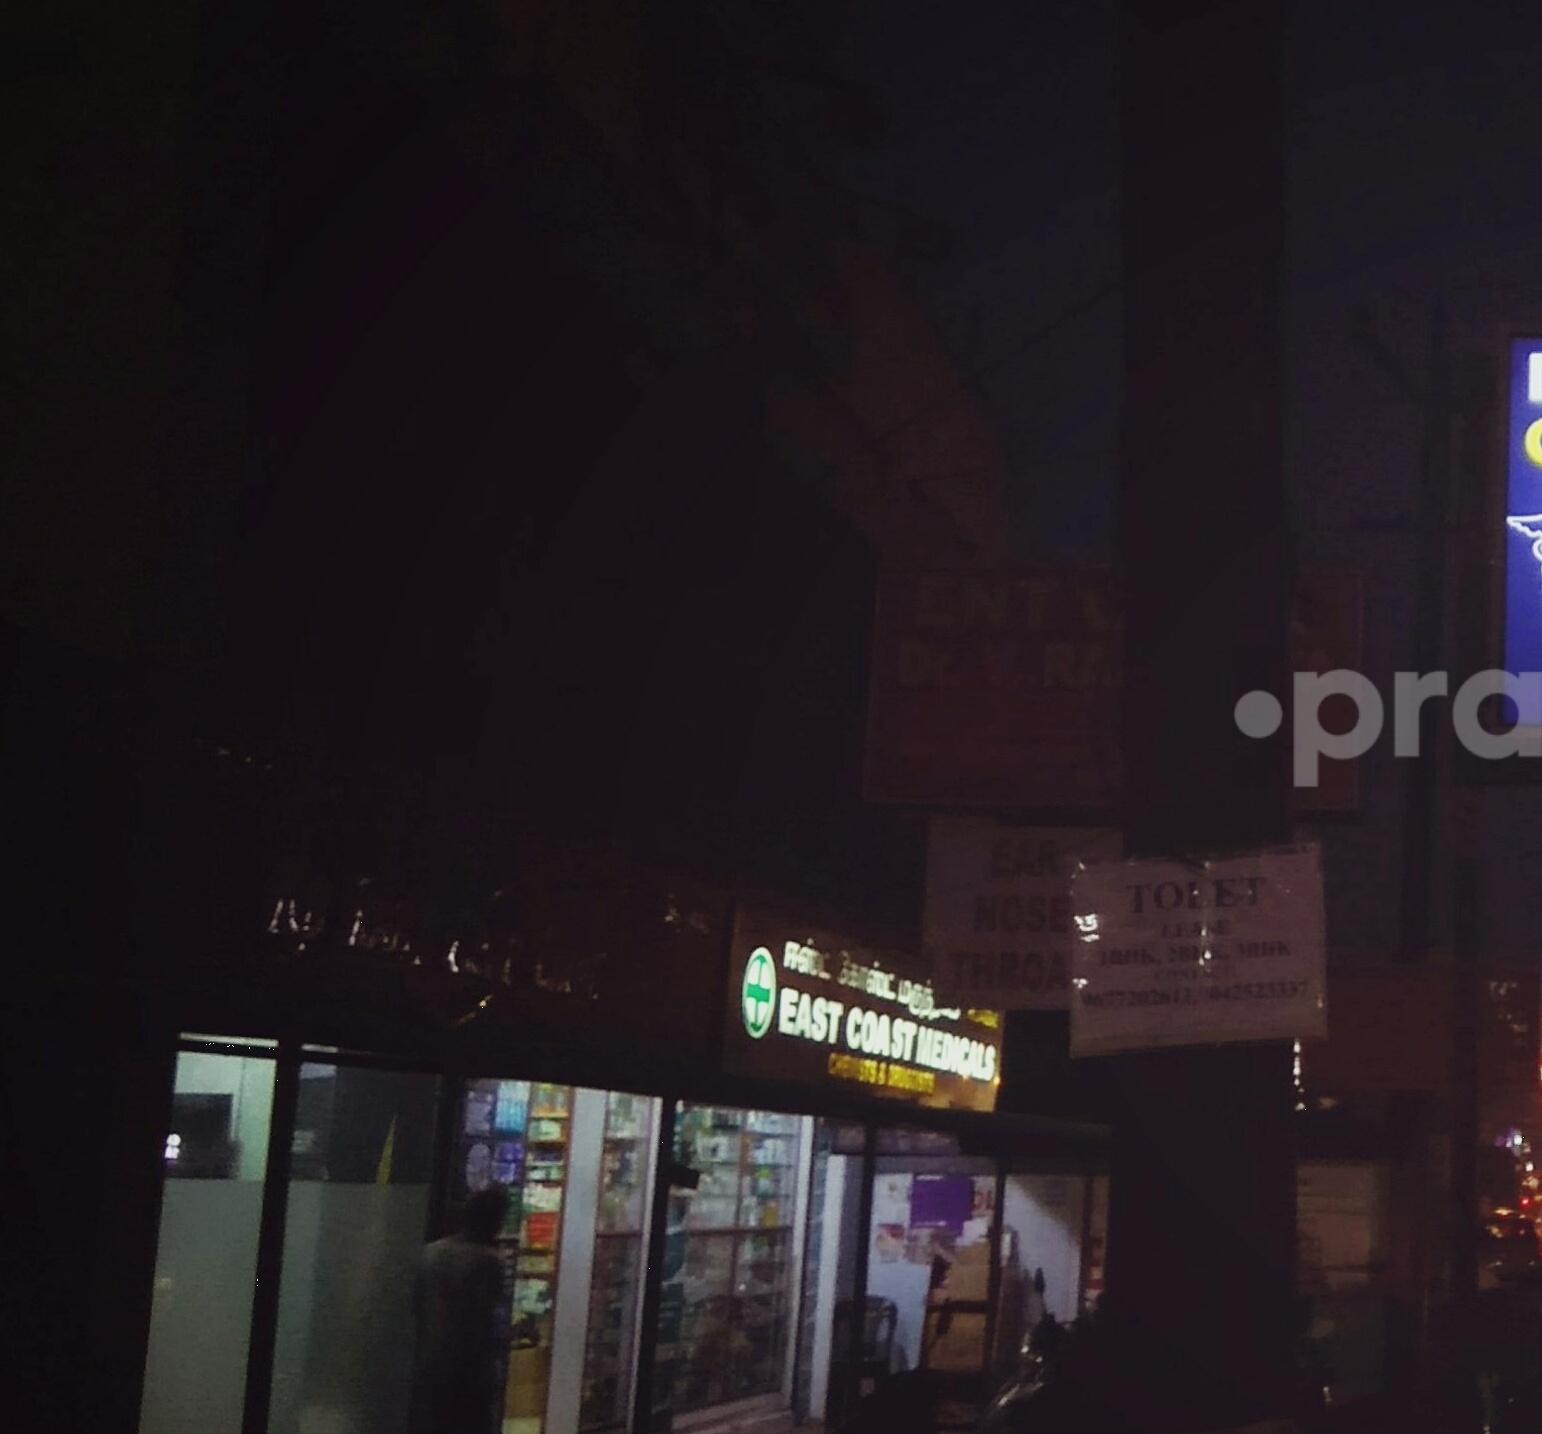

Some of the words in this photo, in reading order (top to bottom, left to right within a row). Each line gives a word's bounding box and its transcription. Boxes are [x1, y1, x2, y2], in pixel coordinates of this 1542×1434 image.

[949, 951, 1071, 992] THROA
[778, 987, 844, 1044] EAST
[846, 1006, 918, 1061] COAST
[914, 1025, 997, 1082] MEDICALS
